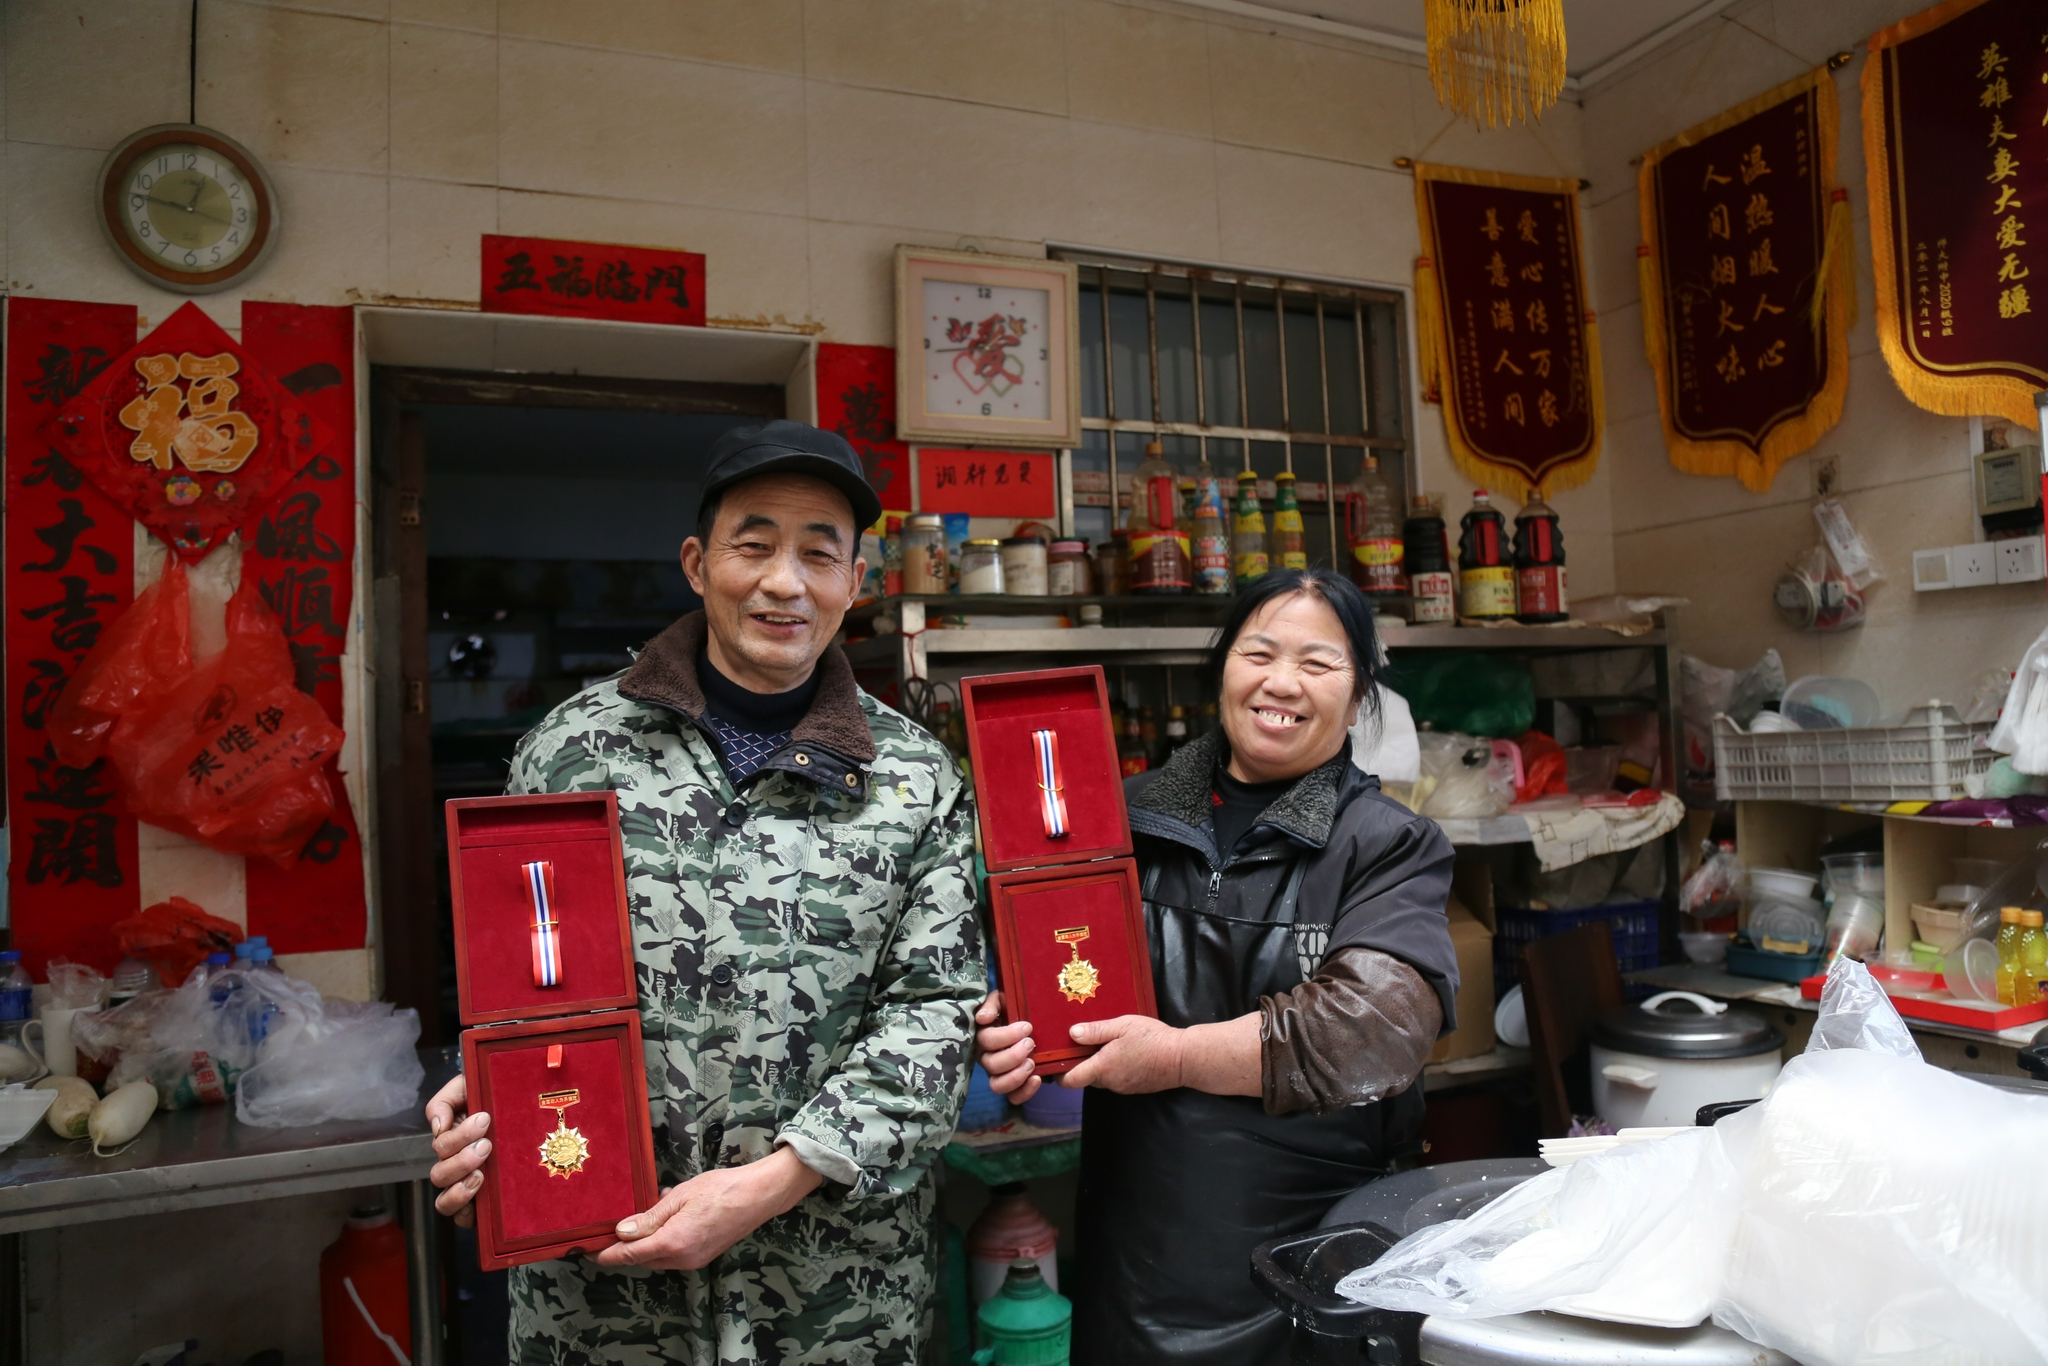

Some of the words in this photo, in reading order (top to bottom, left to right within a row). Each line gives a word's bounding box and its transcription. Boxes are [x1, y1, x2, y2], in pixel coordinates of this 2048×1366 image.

[157, 157, 168, 174] 11
[181, 153, 197, 170] 12
[136, 174, 153, 190] 10
[1976, 42, 2031, 319] 英雄夫妻大爱无疆
[229, 182, 241, 199] 2
[130, 195, 145, 213] 9
[236, 207, 247, 223] 3
[140, 220, 151, 238] 8
[227, 230, 239, 246] 4
[158, 241, 170, 255] 7
[210, 246, 221, 263] 5
[183, 249, 197, 266] 6
[1702, 163, 1747, 385] 人间烟火味
[977, 286, 992, 299] 12
[118, 351, 260, 474] 福
[981, 403, 992, 416] 6
